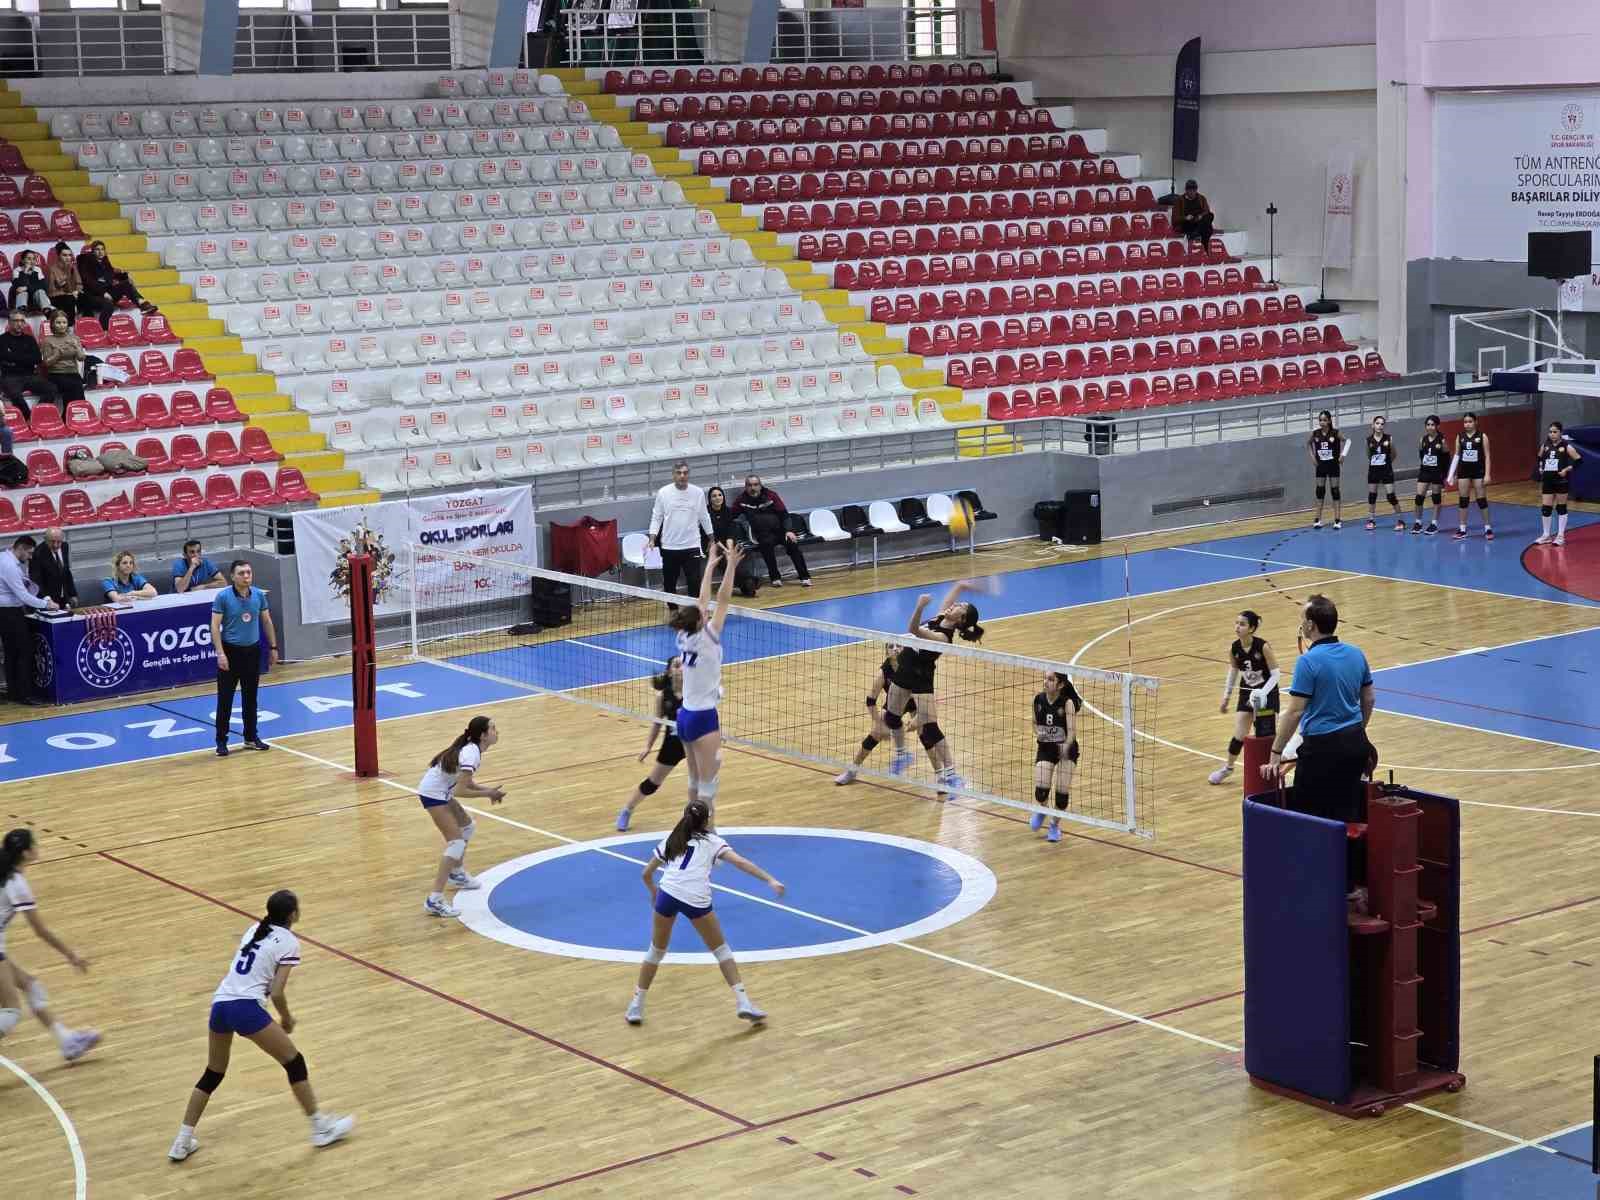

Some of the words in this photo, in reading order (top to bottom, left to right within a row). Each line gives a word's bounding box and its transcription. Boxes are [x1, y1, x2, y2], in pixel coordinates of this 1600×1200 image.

[1514, 154, 1541, 170] TÜM
[1511, 191, 1570, 204] BAŞARILAR
[446, 496, 484, 509] YOZGAT
[419, 528, 455, 545] OKUL
[455, 519, 514, 541] SPORLARI
[141, 624, 222, 653] YOZG
[142, 656, 171, 670] Gençlik
[182, 654, 199, 664] Spor
[1046, 714, 1054, 726] 8
[235, 942, 261, 976] 5
